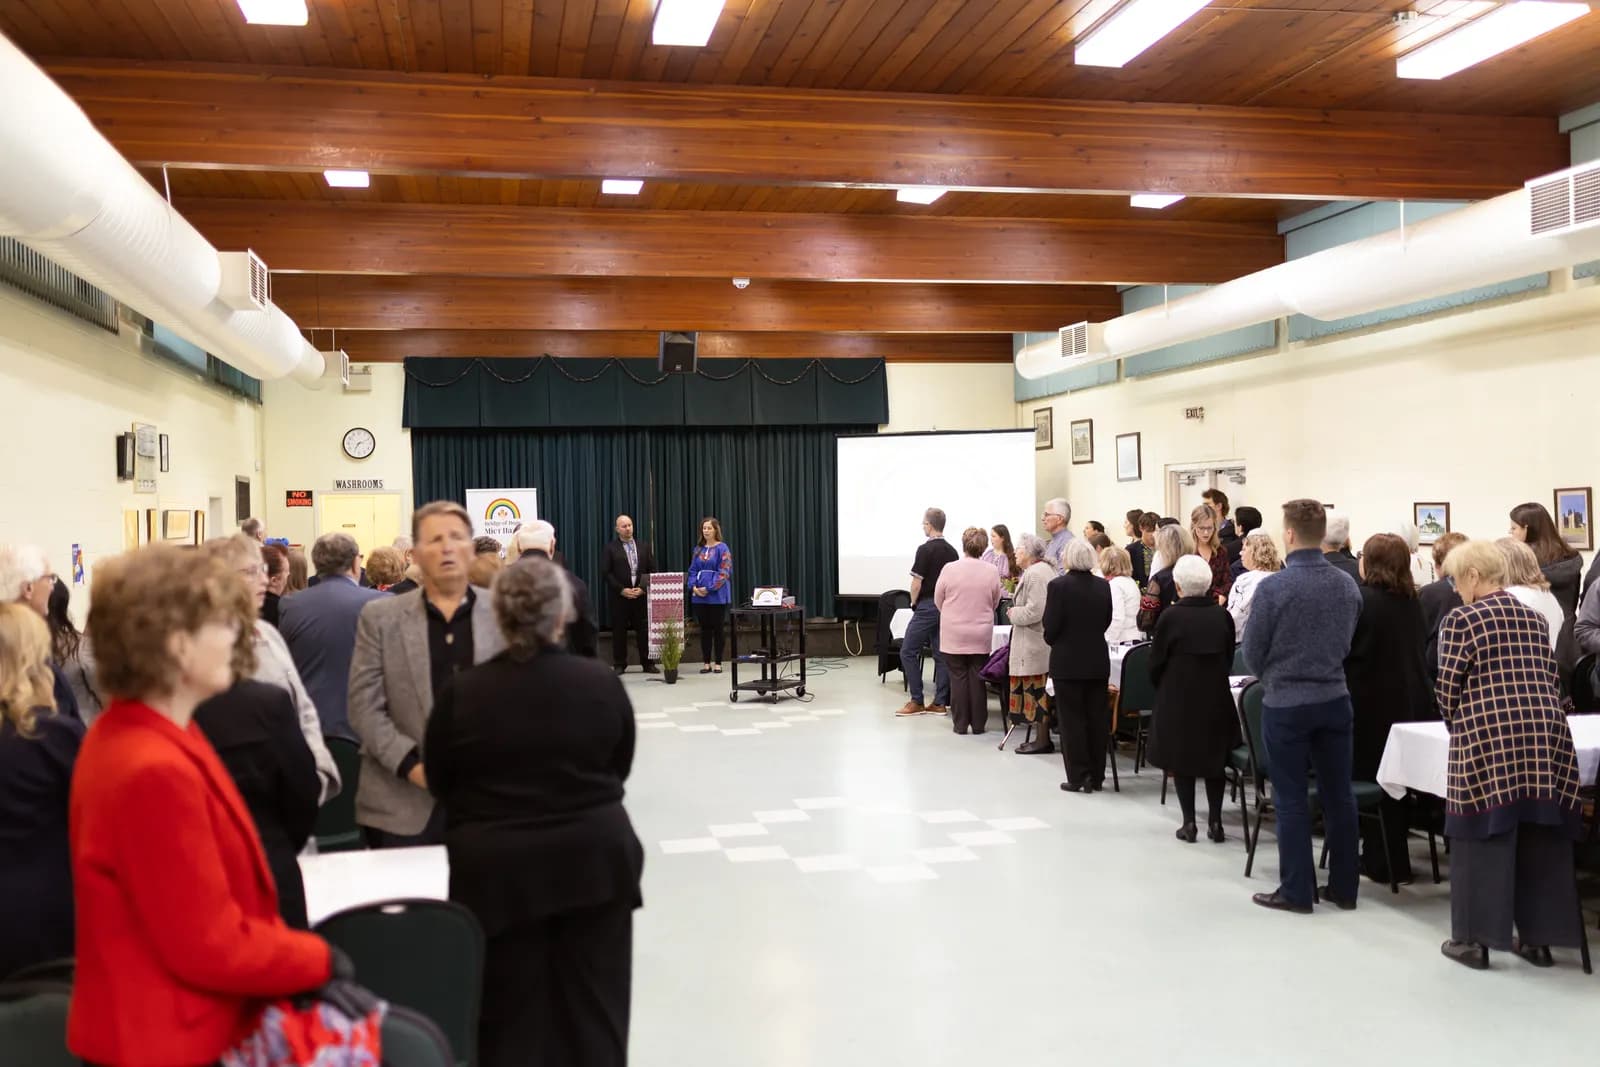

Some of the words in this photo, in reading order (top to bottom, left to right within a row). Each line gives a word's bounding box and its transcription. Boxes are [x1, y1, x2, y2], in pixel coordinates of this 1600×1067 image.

[1186, 408, 1198, 419] EXIT
[335, 479, 384, 489] WASHROOMS
[287, 498, 312, 506] SMOKING
